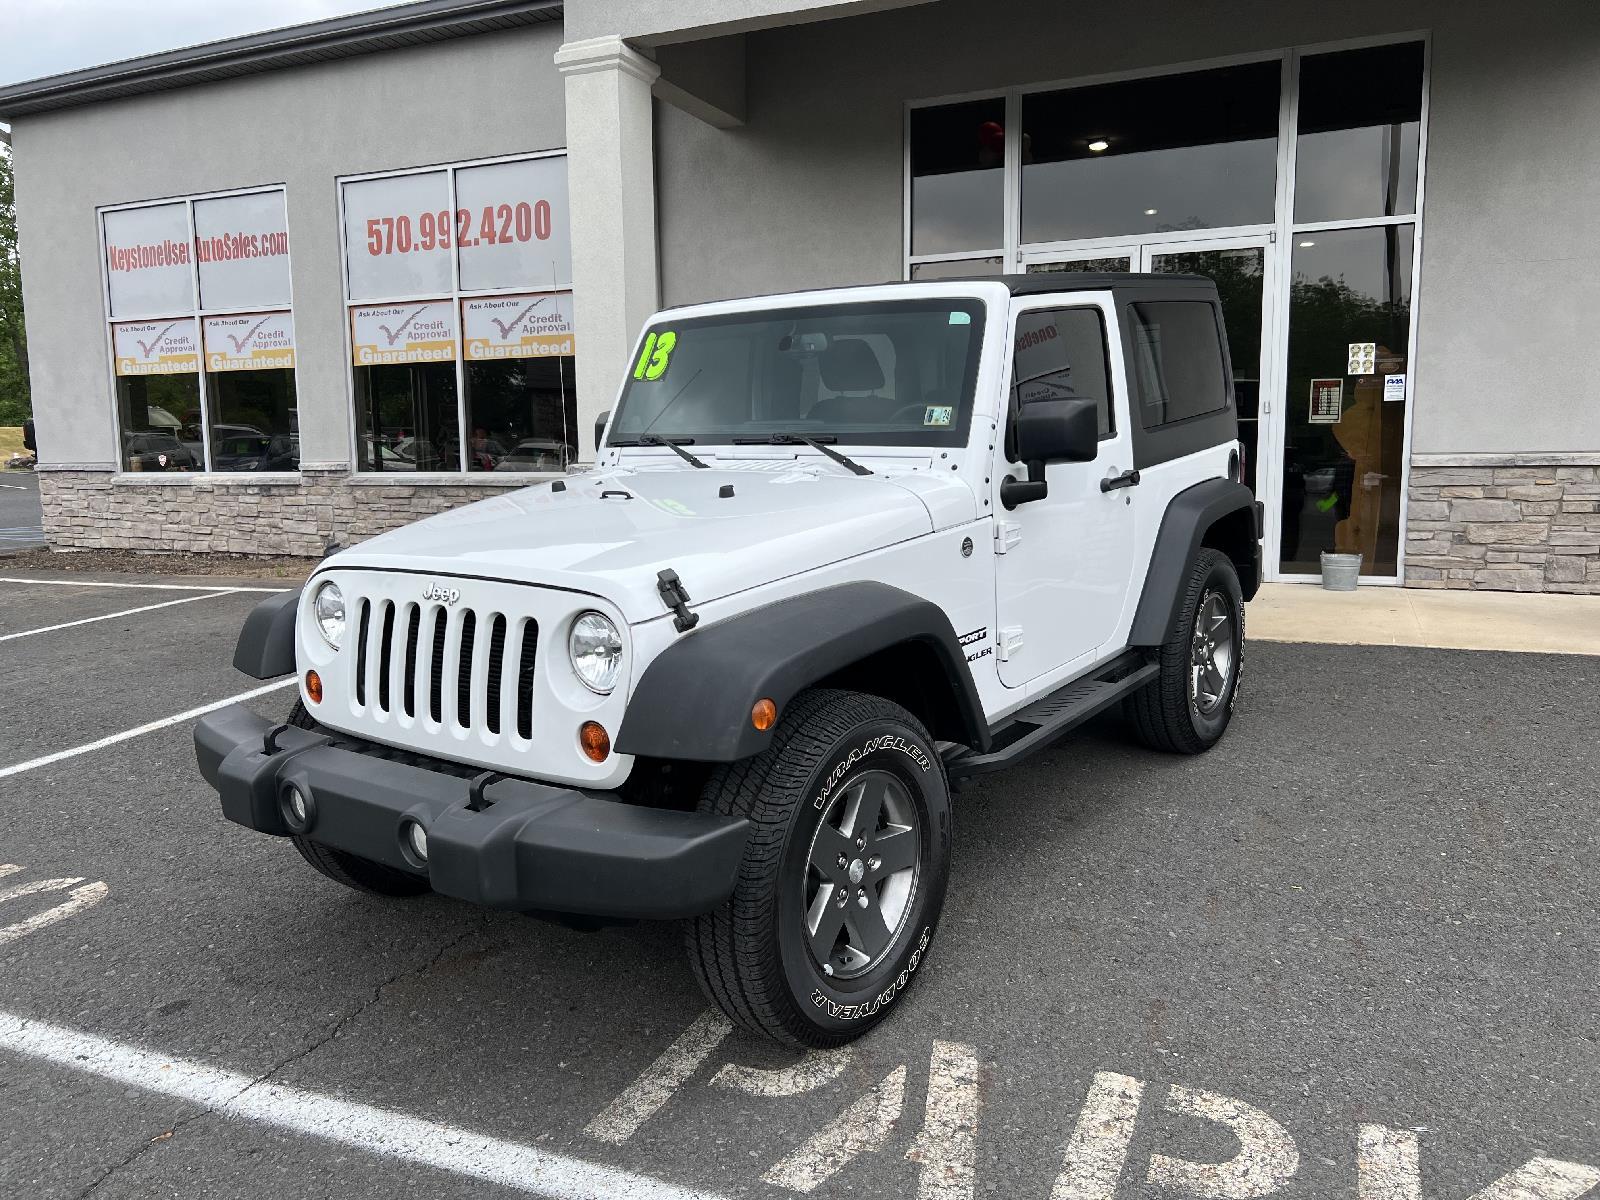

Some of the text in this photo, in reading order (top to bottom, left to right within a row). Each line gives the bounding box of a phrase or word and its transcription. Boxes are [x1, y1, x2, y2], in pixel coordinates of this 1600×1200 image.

[367, 200, 551, 256] 570.992.4200
[483, 301, 504, 309] About
[371, 309, 391, 317] About
[529, 313, 562, 324] Credit
[413, 320, 444, 330] Credit
[522, 322, 570, 334] Approval
[164, 336, 190, 345] Credit
[257, 330, 284, 340] Credit
[407, 329, 451, 340] Approval
[160, 344, 196, 354] Approval
[252, 338, 291, 349] Approval
[469, 340, 571, 358] Guaranteed
[360, 346, 452, 363] Guaranteed
[633, 331, 677, 381] 13
[121, 359, 196, 374] Guaranteed
[211, 353, 292, 370] Guaranteed
[423, 582, 461, 606] Jeep
[958, 629, 987, 644] PORT
[814, 735, 931, 810] WRANGLER
[810, 926, 931, 1020] GOODYEAR
